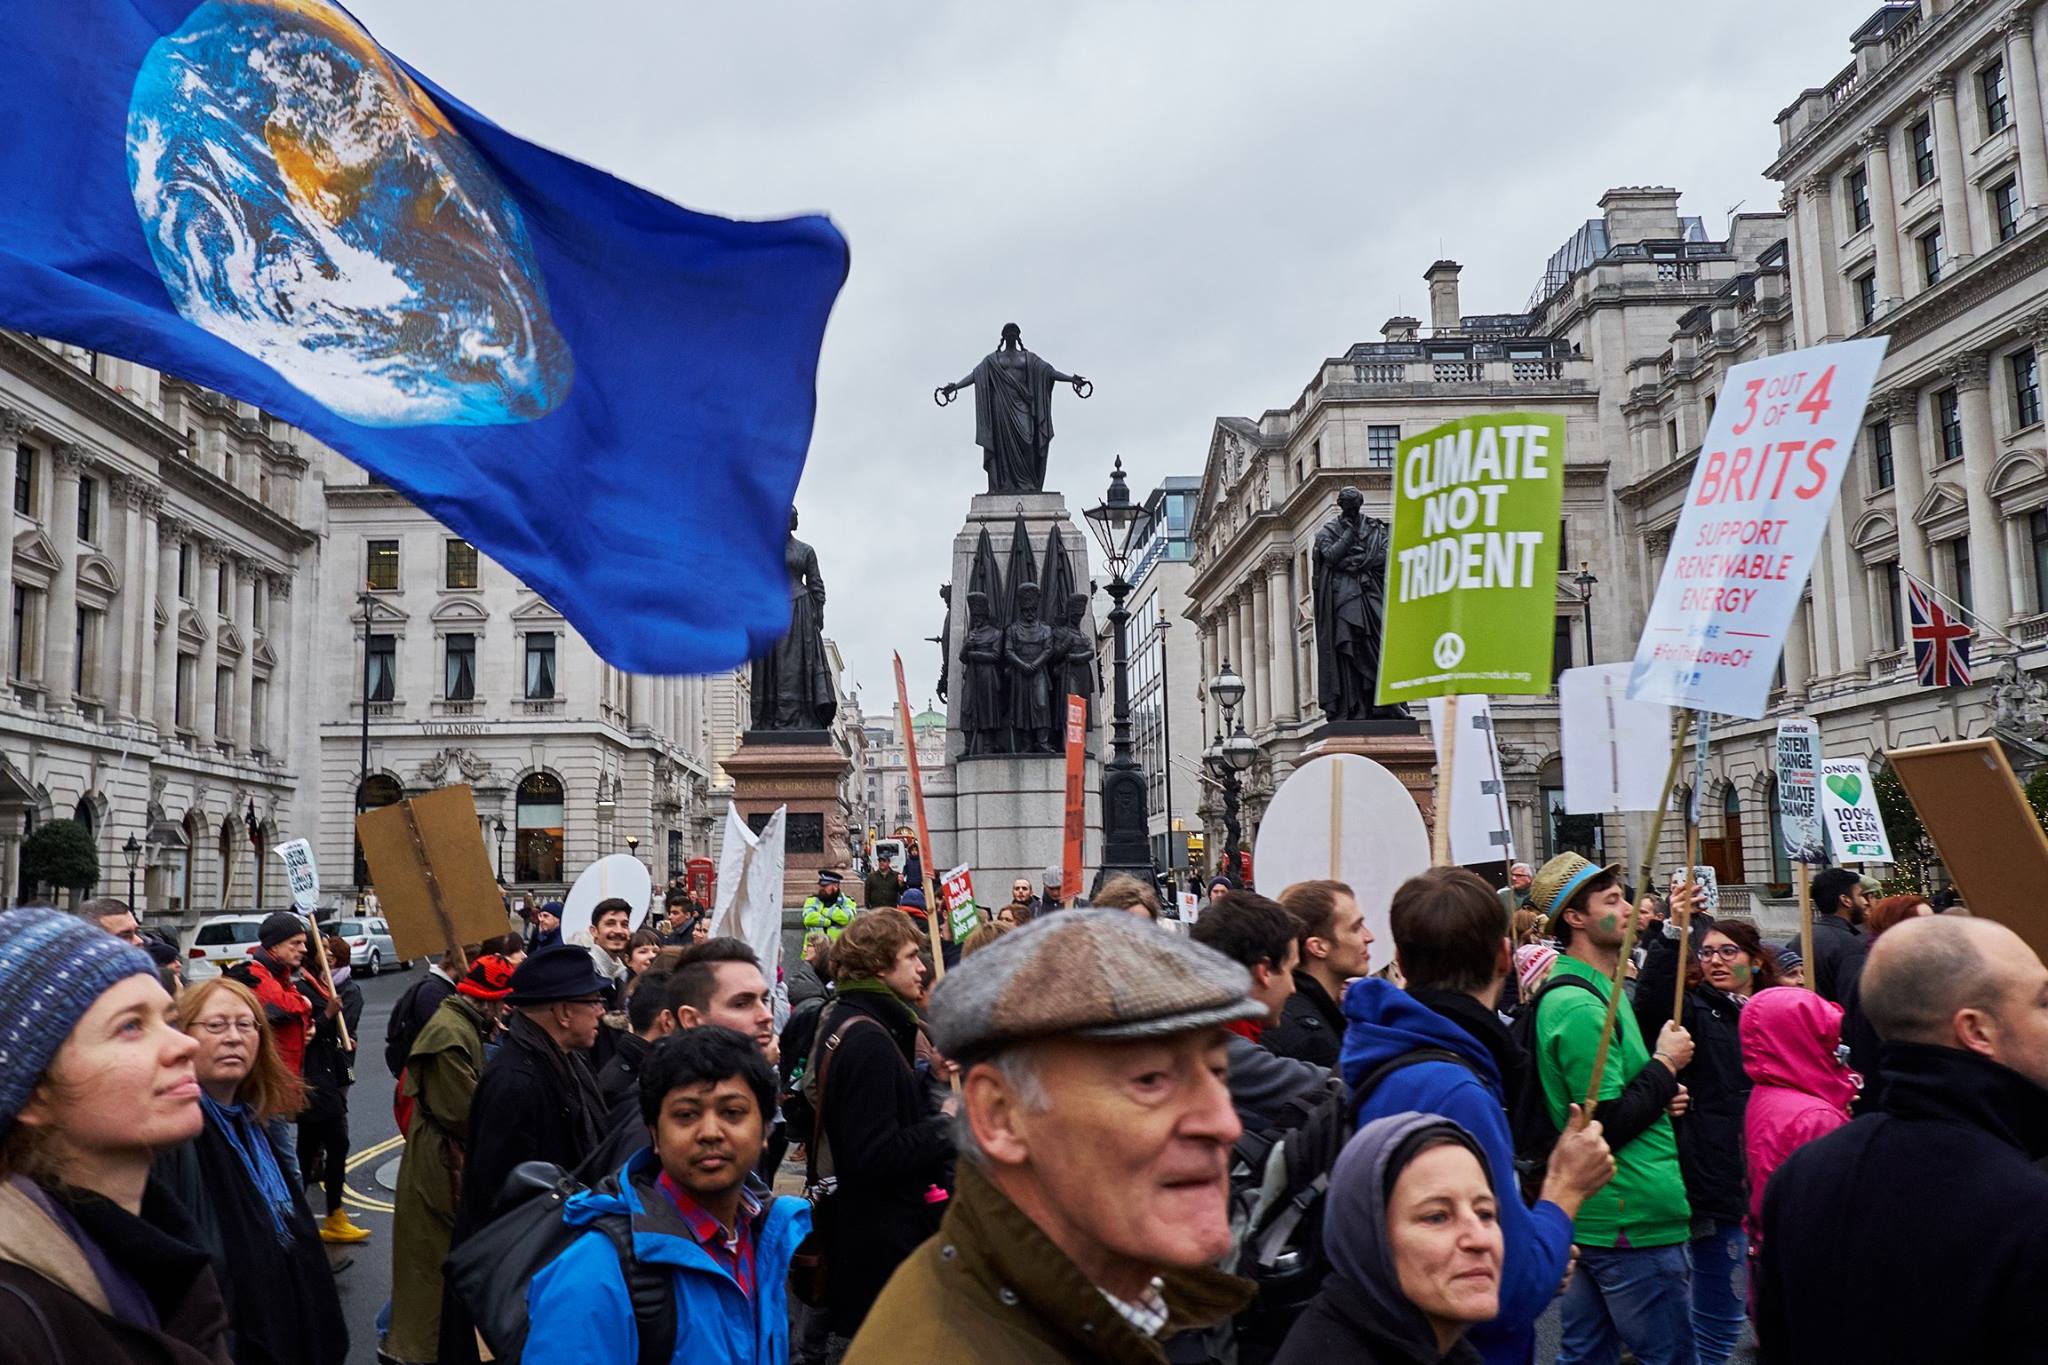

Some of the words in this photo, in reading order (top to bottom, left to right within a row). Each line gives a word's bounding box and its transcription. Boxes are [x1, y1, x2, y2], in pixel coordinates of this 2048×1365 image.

[1767, 372, 1808, 399] OUT
[1795, 364, 1836, 425] 4
[1732, 378, 1766, 435] 3
[1763, 403, 1791, 427] OF
[1403, 424, 1550, 500] CLIMATE
[1695, 438, 1837, 506] BRITS
[1422, 484, 1509, 538] NOT
[1696, 519, 1789, 547] SUPPORT
[1398, 531, 1544, 603] TRIDENT
[1675, 553, 1794, 580] RENEWABLE
[1679, 587, 1759, 614] ENERGY
[422, 724, 484, 737] VILLANDRY
[1778, 736, 1810, 753] SYSTEM
[1778, 753, 1813, 769] CHANGE
[1780, 784, 1816, 803] CLIMATE
[1780, 800, 1815, 818] CHANGE
[1834, 808, 1876, 821] 100%
[1839, 822, 1879, 832] CLEAN
[1843, 834, 1881, 843] ENERGY
